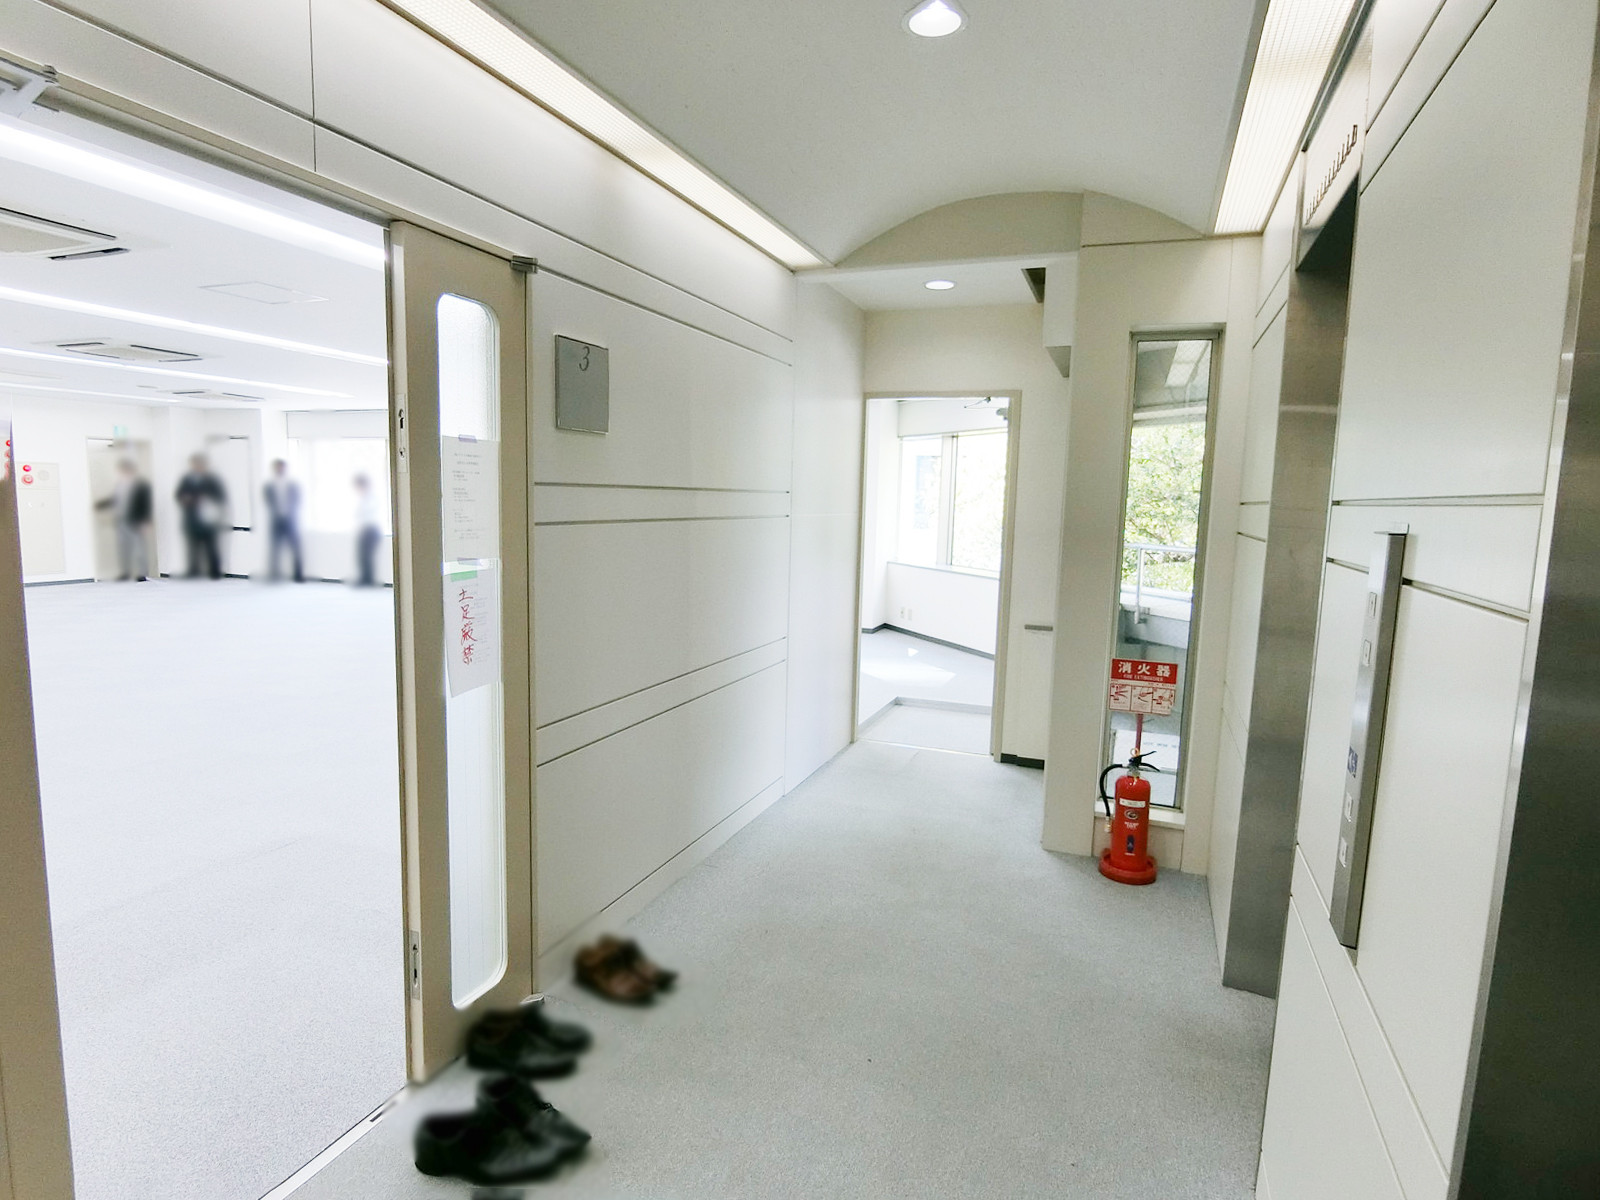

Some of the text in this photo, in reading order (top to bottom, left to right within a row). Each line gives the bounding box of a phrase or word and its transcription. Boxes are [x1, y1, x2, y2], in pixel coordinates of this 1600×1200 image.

[579, 346, 590, 371] 3
[1118, 661, 1171, 677] 消火器
